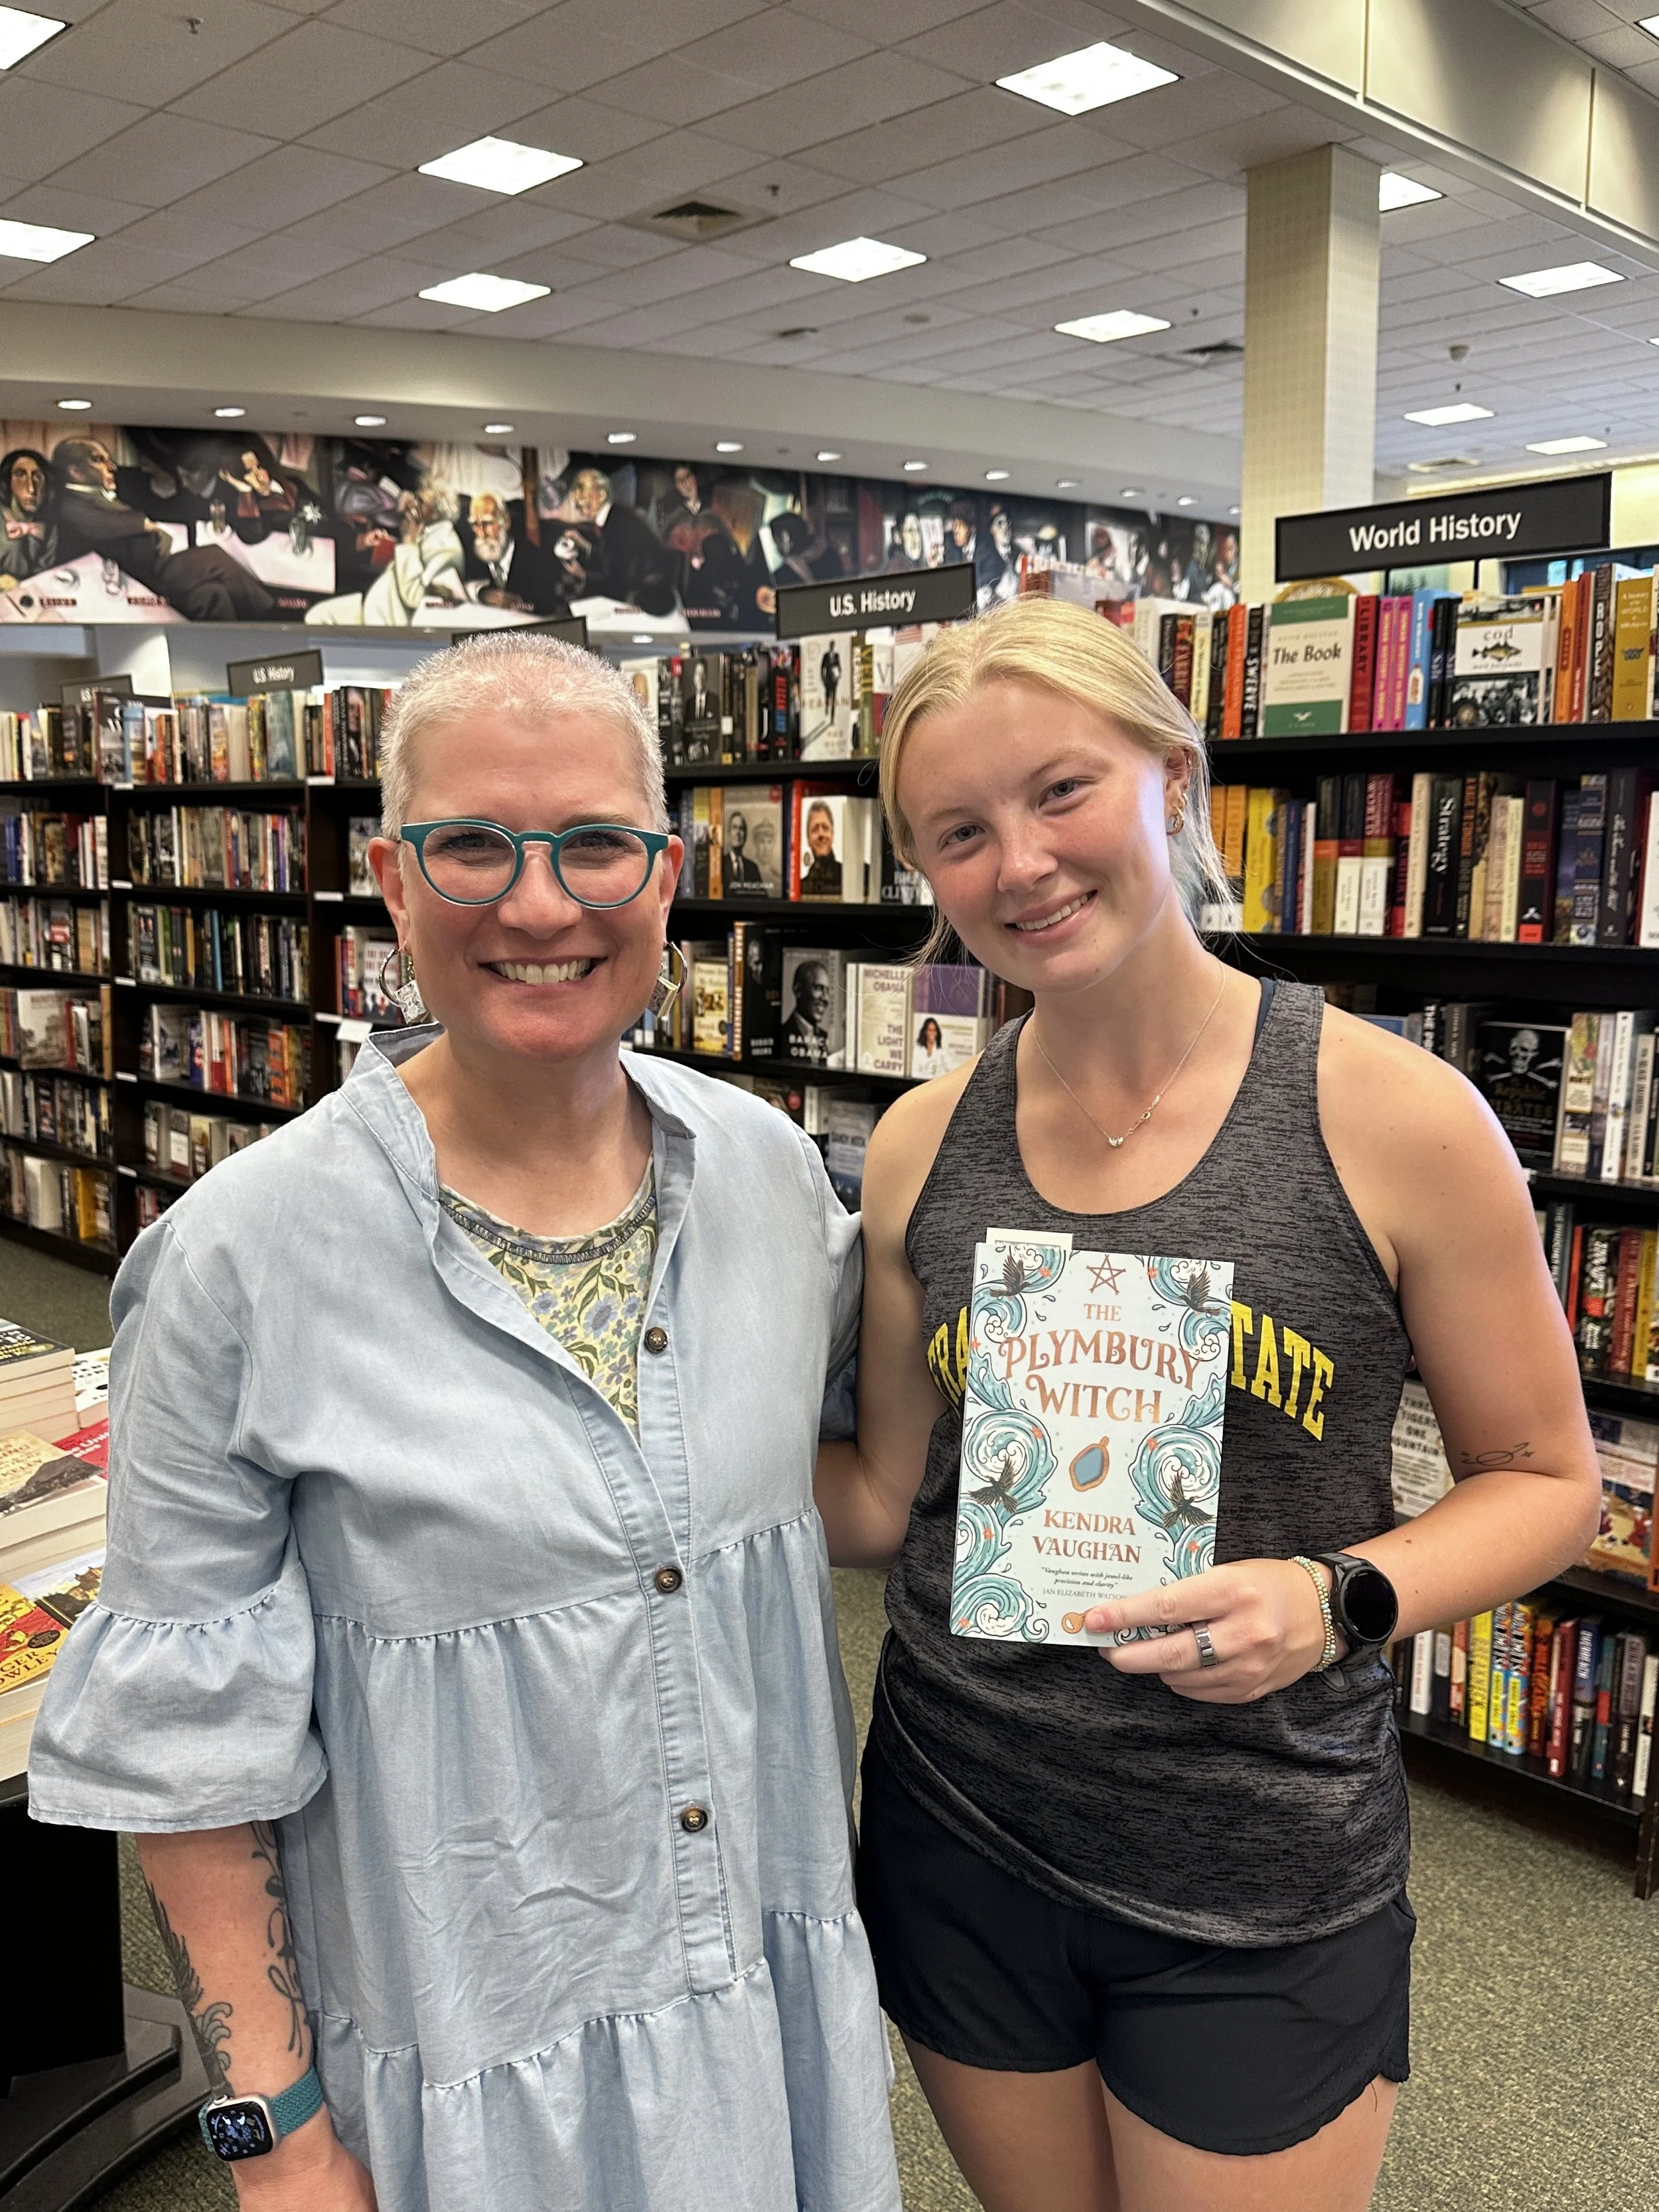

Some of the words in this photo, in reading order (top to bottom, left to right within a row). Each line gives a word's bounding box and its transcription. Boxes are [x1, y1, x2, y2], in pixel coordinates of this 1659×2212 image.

[1350, 519, 1421, 552] World
[1429, 512, 1521, 543] History
[830, 596, 857, 617] U.S.
[861, 590, 916, 613] History
[1358, 608, 1369, 673] LIBRARY
[1483, 626, 1514, 642] cod
[1273, 646, 1299, 665] The
[1303, 642, 1342, 663] Book
[267, 666, 295, 683] History
[1243, 657, 1260, 711] SWERVE
[1431, 797, 1456, 874] Strategy
[863, 968, 905, 980] MICHELLE
[887, 1023, 903, 1035] THE
[877, 1036, 904, 1047] LIGHT
[873, 1060, 903, 1071] CARRY
[889, 1050, 903, 1060] WE
[1083, 1303, 1121, 1322] THE
[997, 1329, 1205, 1391] PLYMBURY
[1025, 1374, 1163, 1424] WITCH
[1043, 1509, 1137, 1537] KENDRA
[1032, 1535, 1142, 1564] VAUGHAN
[1057, 1589, 1096, 1598] ELIZABETH
